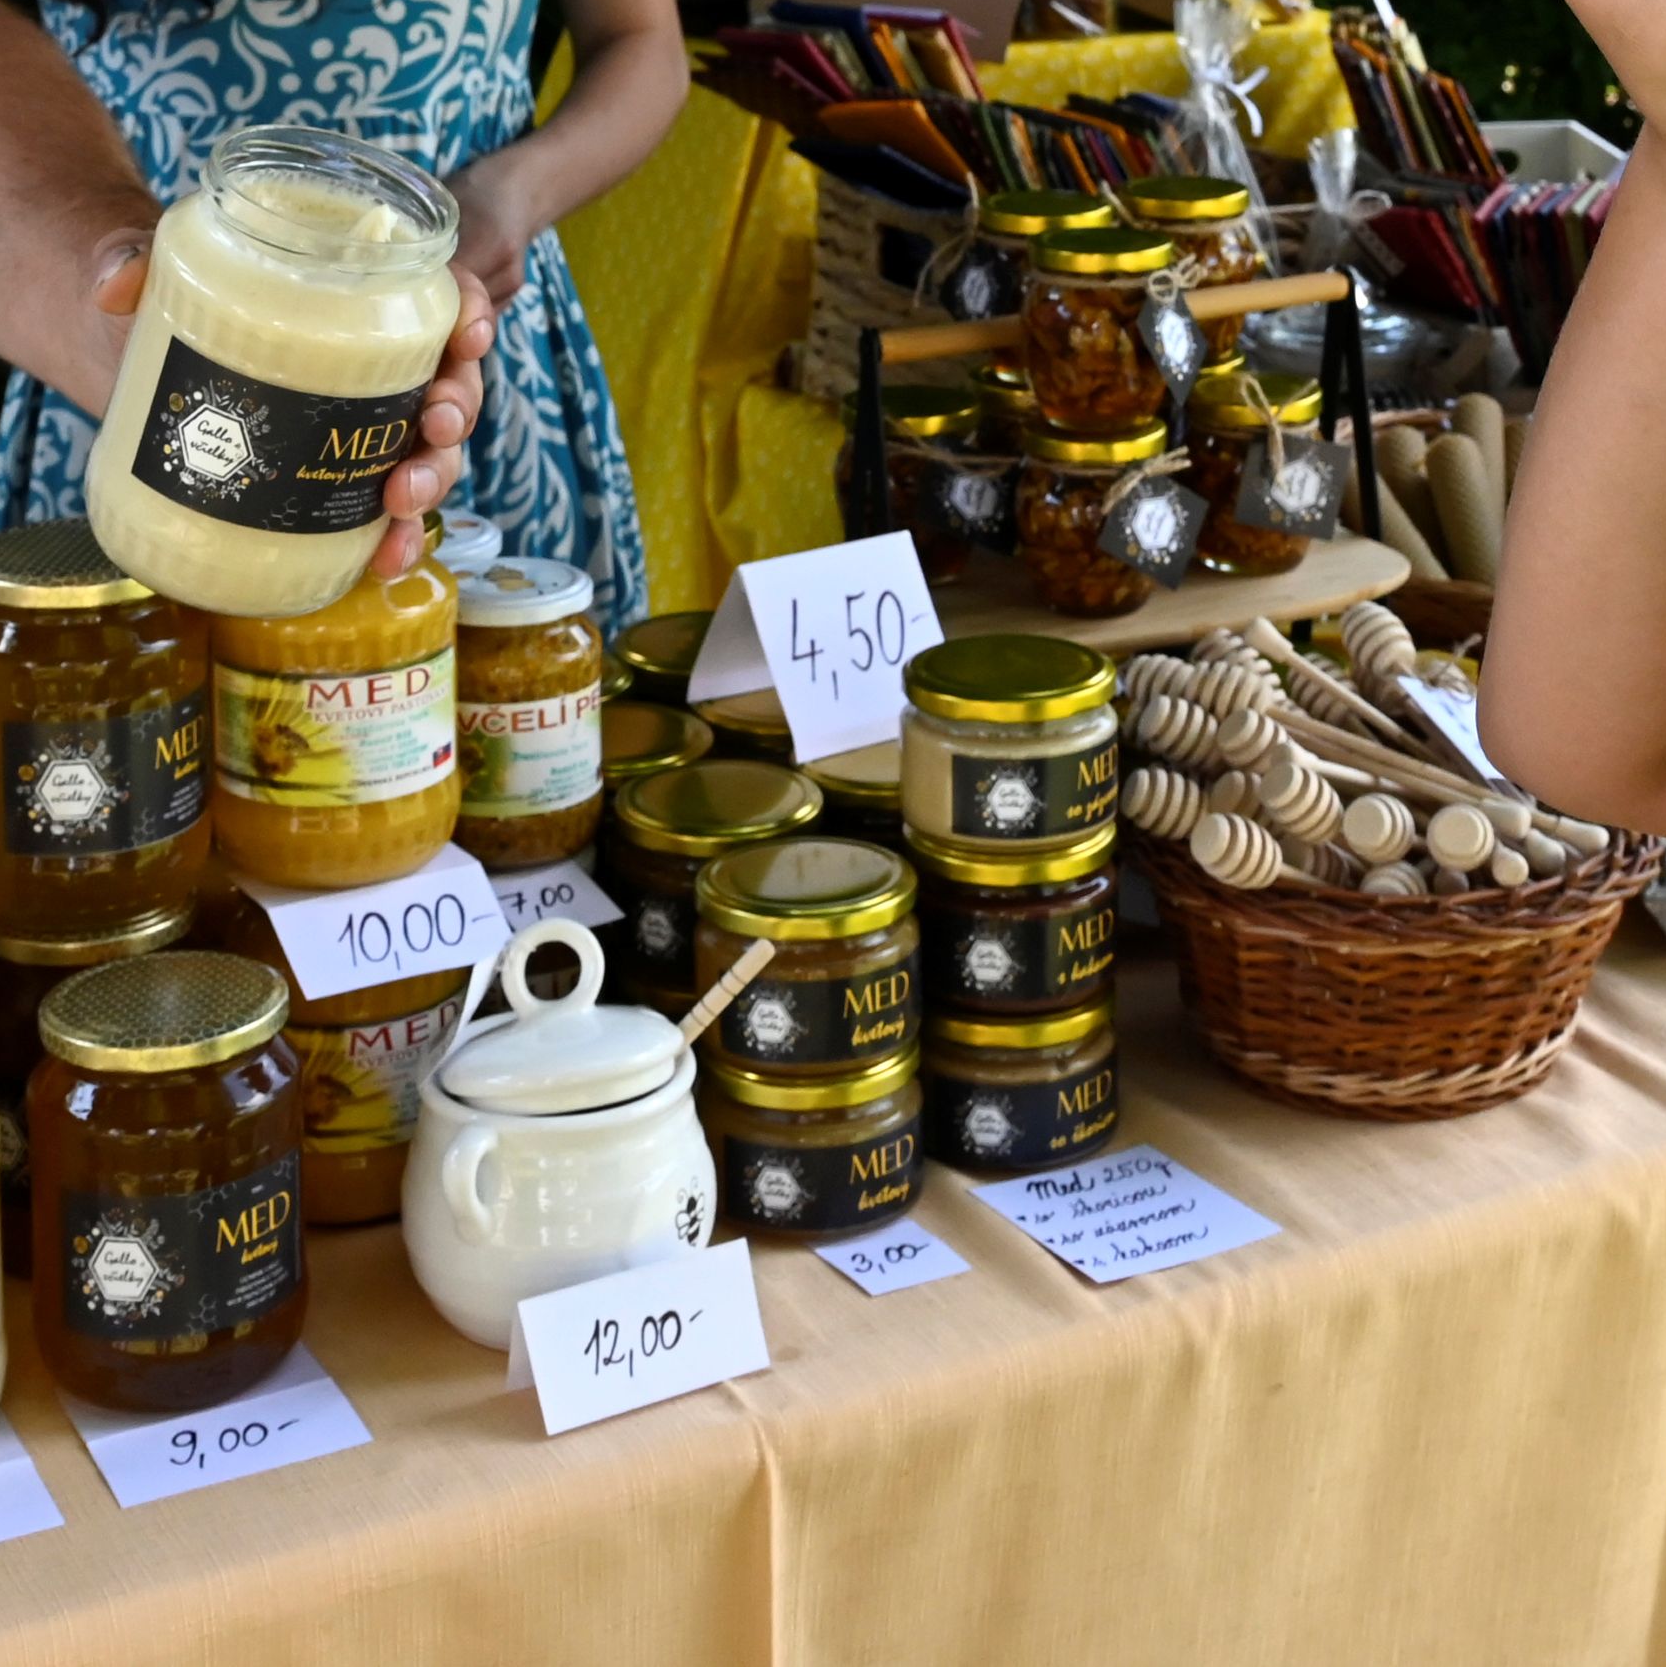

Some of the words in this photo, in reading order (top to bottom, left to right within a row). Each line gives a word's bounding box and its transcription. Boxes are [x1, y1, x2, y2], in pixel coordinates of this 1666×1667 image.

[197, 419, 232, 444] Gallo
[318, 419, 407, 460] MED
[306, 666, 432, 709] MED
[457, 695, 566, 734] VČELÍ
[1058, 908, 1114, 957] MED
[842, 971, 909, 1019] MED
[349, 1000, 462, 1057] MED
[1057, 1069, 1113, 1120] MED
[849, 1133, 914, 1184] MED
[216, 1190, 290, 1253] MED
